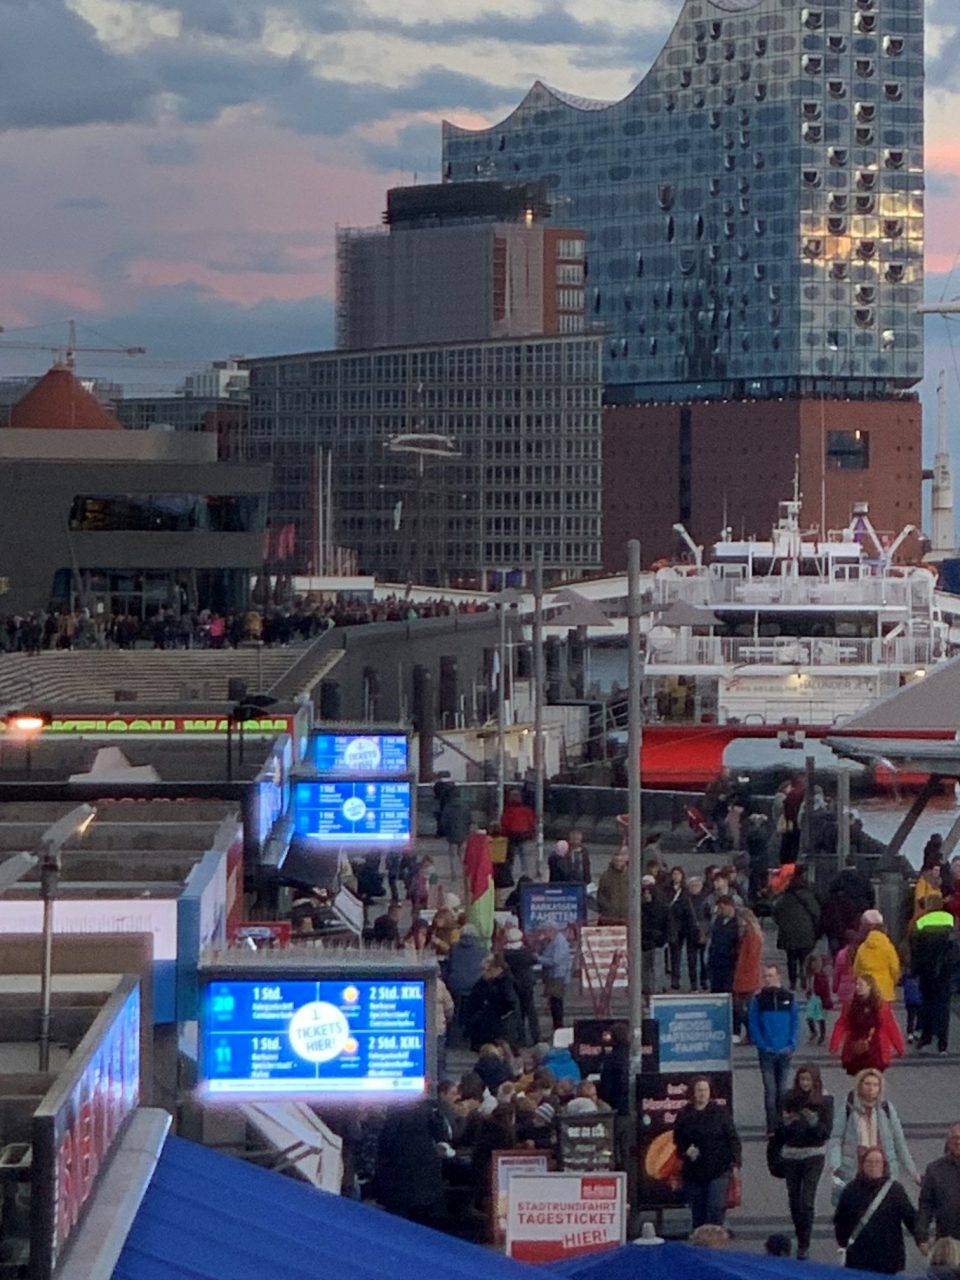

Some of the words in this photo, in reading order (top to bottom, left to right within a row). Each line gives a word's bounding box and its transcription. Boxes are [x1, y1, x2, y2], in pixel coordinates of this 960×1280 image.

[296, 1022, 342, 1040] TICKETS
[306, 1038, 336, 1053] HIER!
[517, 1202, 617, 1212] STADTRUNDFAHRT
[517, 1213, 616, 1225] TAGESTICKET
[564, 1230, 607, 1247] HIER!
